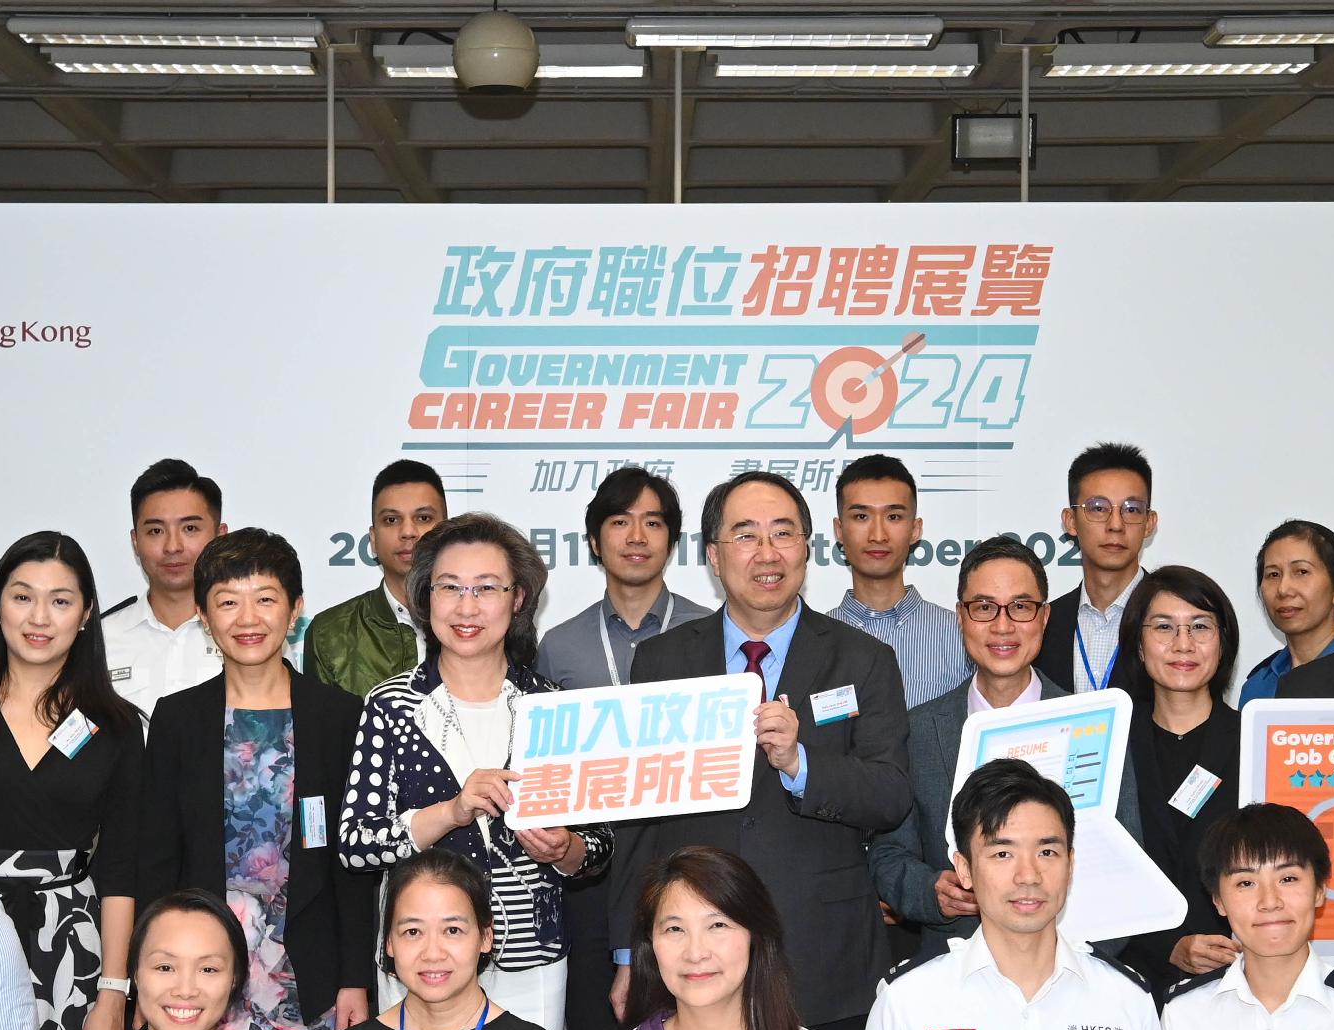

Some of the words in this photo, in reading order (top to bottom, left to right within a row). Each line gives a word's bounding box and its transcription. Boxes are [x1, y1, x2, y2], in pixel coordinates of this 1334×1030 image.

[432, 244, 1053, 318] 政府職位招聘展覽
[21, 320, 92, 348] Kong
[408, 393, 607, 430] CAREER
[619, 391, 739, 430] FAIR
[746, 346, 1035, 434] 2024
[524, 686, 749, 759] 加入政府
[1283, 749, 1322, 765] Job
[517, 744, 743, 818] 盡展所長
